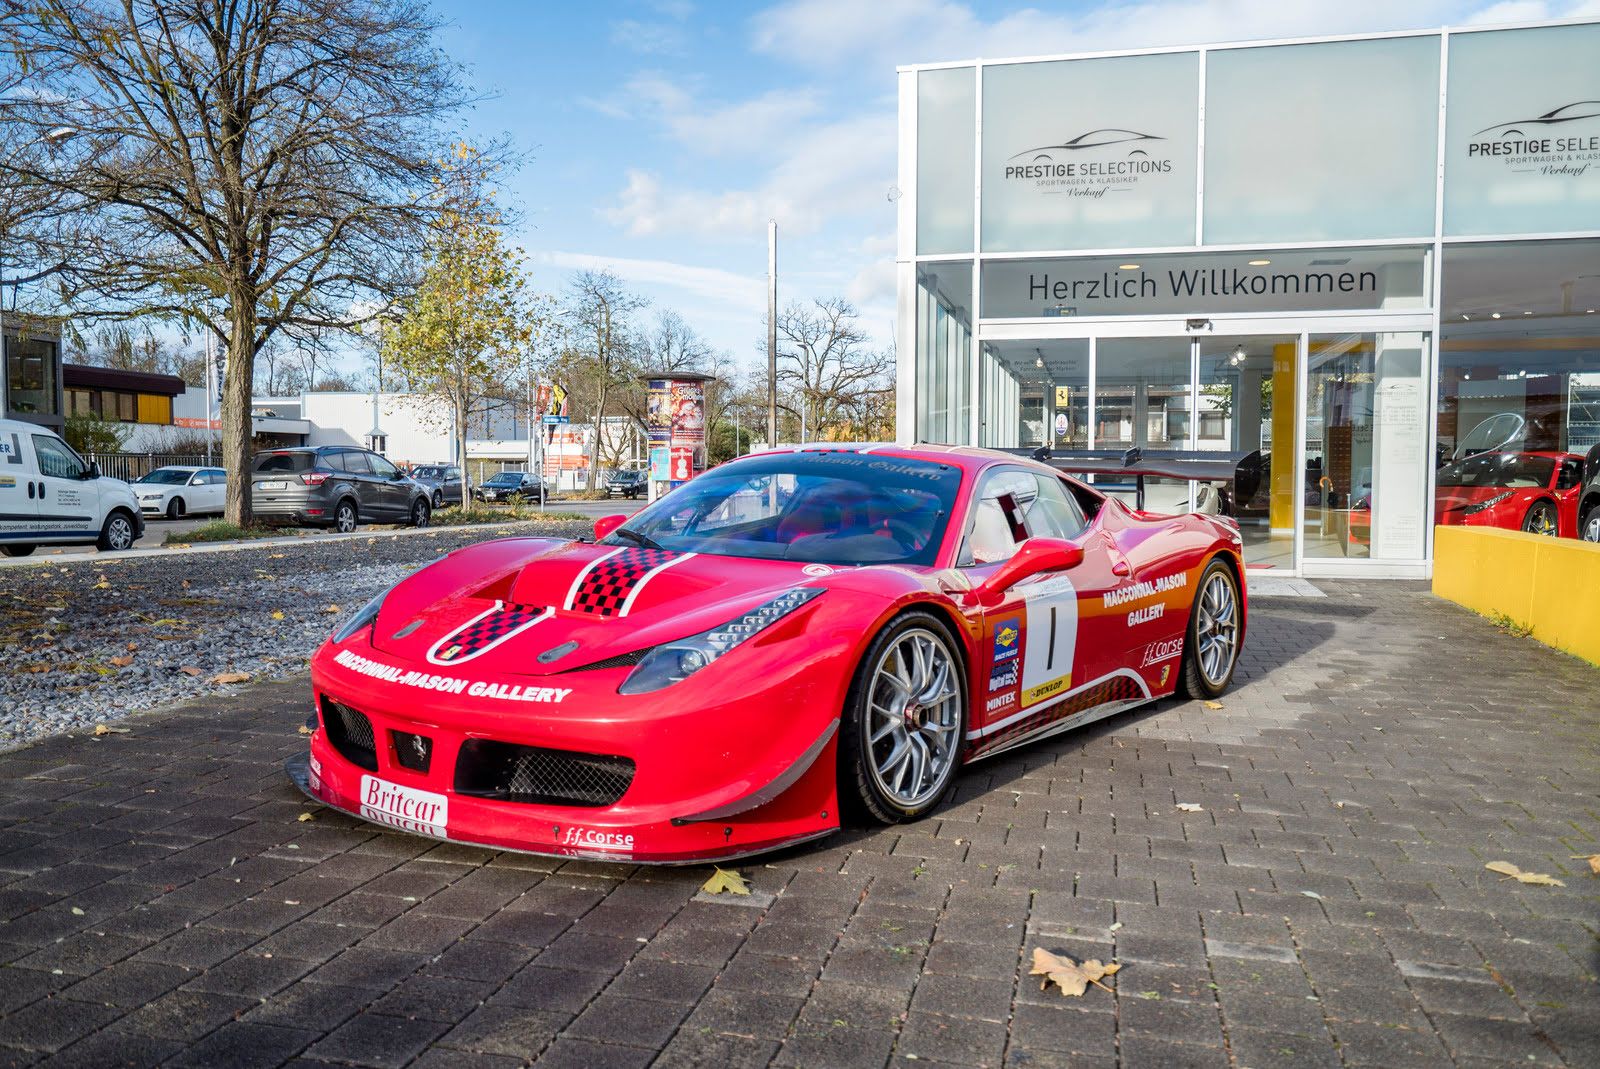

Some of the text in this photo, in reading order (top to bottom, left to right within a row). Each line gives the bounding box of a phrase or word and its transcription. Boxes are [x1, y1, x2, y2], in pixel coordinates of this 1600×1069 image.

[1469, 137, 1599, 157] PRESTIGE SELE
[1005, 160, 1172, 179] PRESTIGE SELECTIONS
[1505, 155, 1563, 165] SPORTWAGEN
[1540, 163, 1591, 176] Verkauf
[1036, 178, 1086, 187] SPORTWAGEN
[1097, 176, 1138, 184] KLASSIKER
[1066, 186, 1110, 198] Verkauf
[1029, 268, 1377, 300] Herzlich Willkommen
[1127, 602, 1166, 627] GALLERY
[333, 649, 573, 703] MACCONNAL-MASON GALLERY
[1036, 680, 1063, 697] DUNLOP
[987, 691, 1016, 711] MINTEX
[367, 779, 440, 821] Britcar
